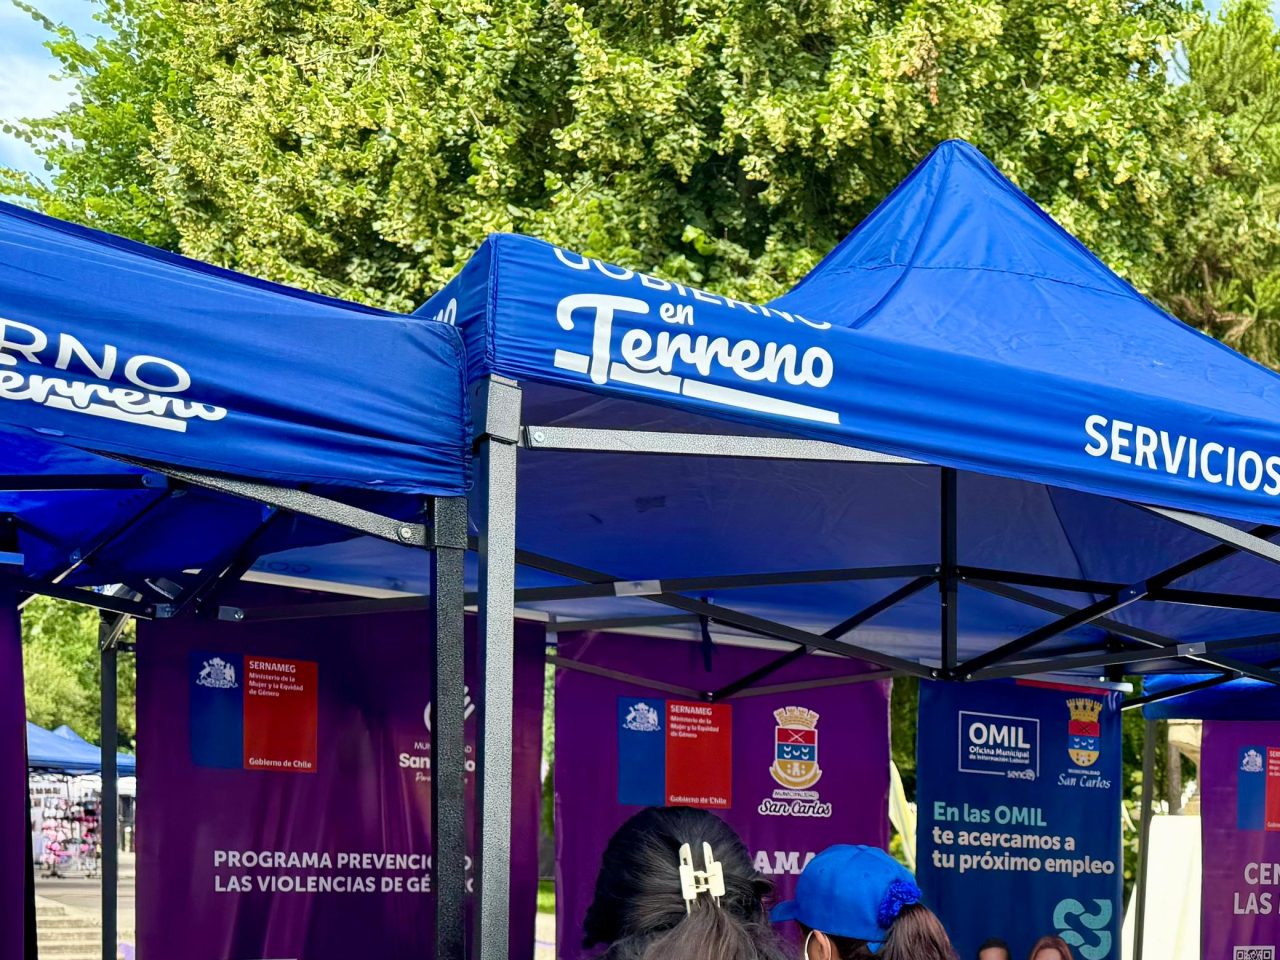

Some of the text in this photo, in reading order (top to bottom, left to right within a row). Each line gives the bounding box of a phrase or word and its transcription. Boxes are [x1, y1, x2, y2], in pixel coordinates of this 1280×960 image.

[660, 303, 694, 326] en
[556, 293, 833, 388] Terreno
[0, 368, 228, 421] erreno
[249, 661, 297, 674] SERNAMEG
[248, 672, 281, 682] Ministerio
[248, 680, 267, 690] Mujer
[279, 683, 304, 692] Equidad
[670, 704, 713, 716] SERNAMEG
[968, 722, 1031, 748] OMIL
[969, 745, 1030, 758] Oficina Municipal
[248, 757, 313, 769] Gobierno de Chile
[399, 752, 431, 770] San
[1057, 773, 1112, 789] San Carlos
[760, 800, 832, 815] San Carlos
[933, 801, 1047, 827] En las OMIL
[932, 826, 1076, 851] te acercamos a
[213, 850, 432, 870] PROGRAMA PREVENCI
[932, 850, 1115, 878] tu próximo empleo
[214, 875, 253, 892] LAS
[256, 876, 376, 893] VIOLENCIAS
[380, 877, 403, 893] DE
[1234, 893, 1273, 915] LAS
